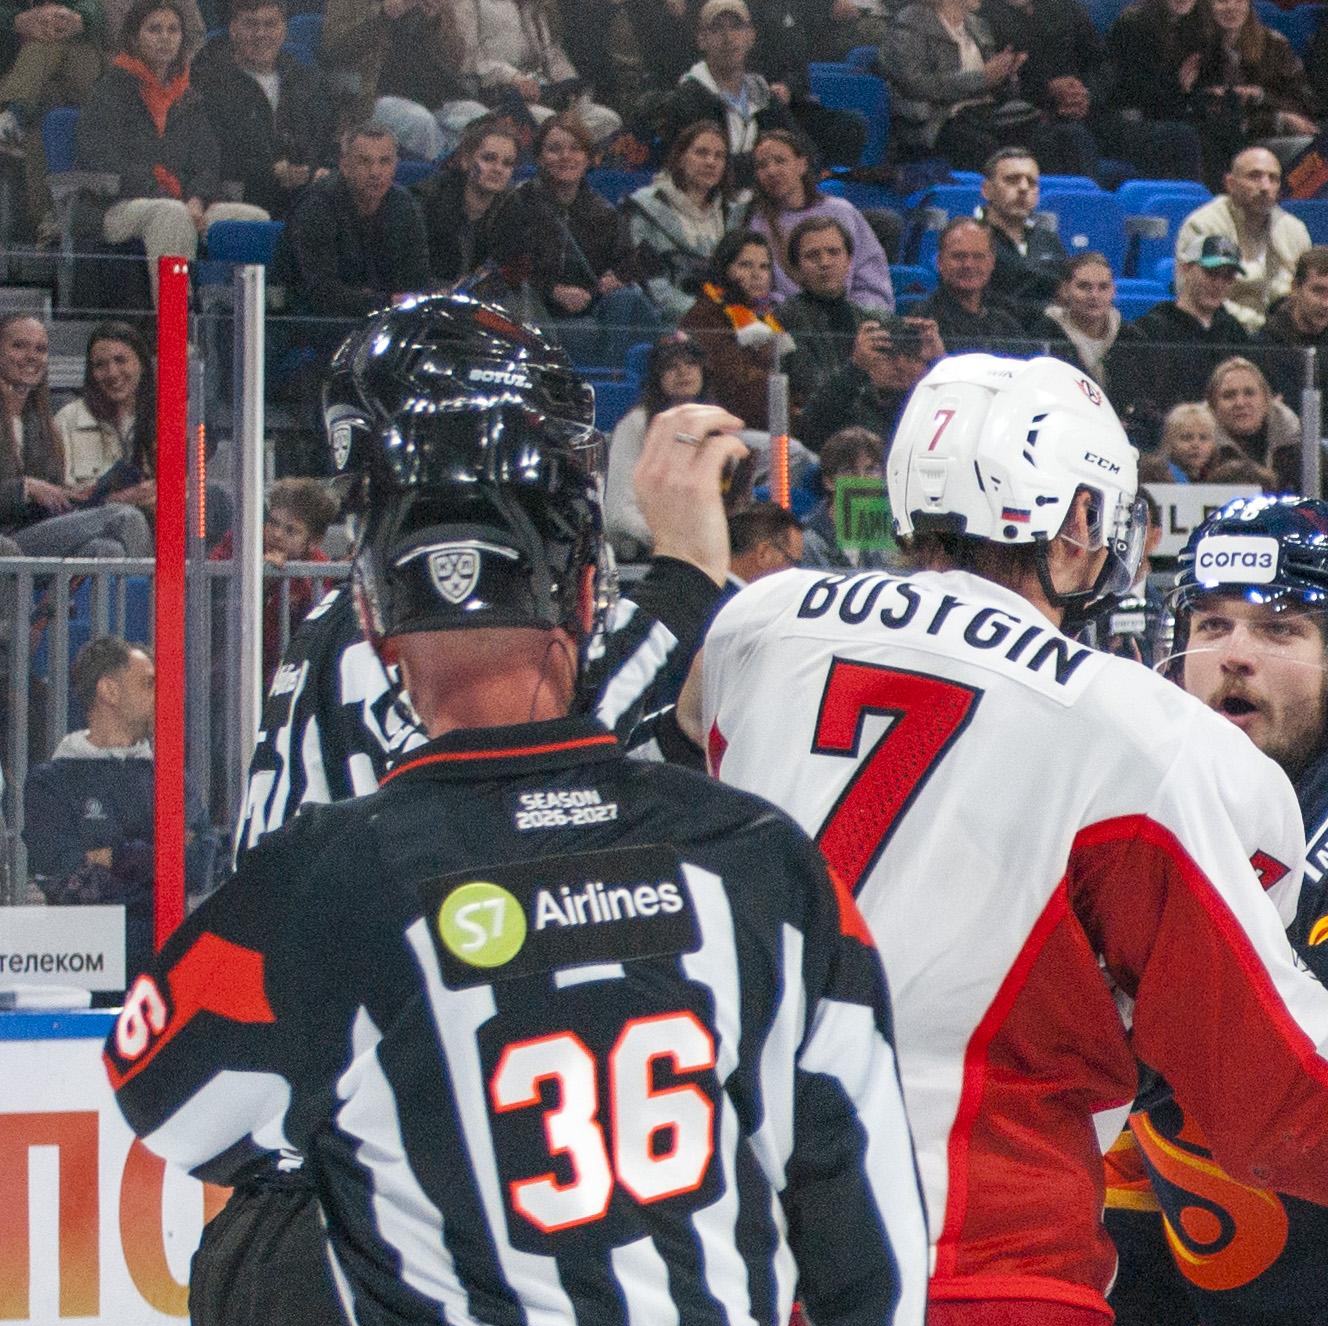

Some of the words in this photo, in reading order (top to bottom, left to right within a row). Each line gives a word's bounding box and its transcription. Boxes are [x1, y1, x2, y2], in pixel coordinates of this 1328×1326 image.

[928, 409, 956, 451] 7
[1084, 452, 1121, 474] CCM
[1199, 551, 1274, 570] согаз
[810, 655, 985, 896] 7
[515, 803, 618, 831] 2026-2027
[519, 790, 602, 810] SEASON
[454, 897, 505, 952] S7
[536, 881, 684, 931] Airlines
[489, 1009, 716, 1234] 36
